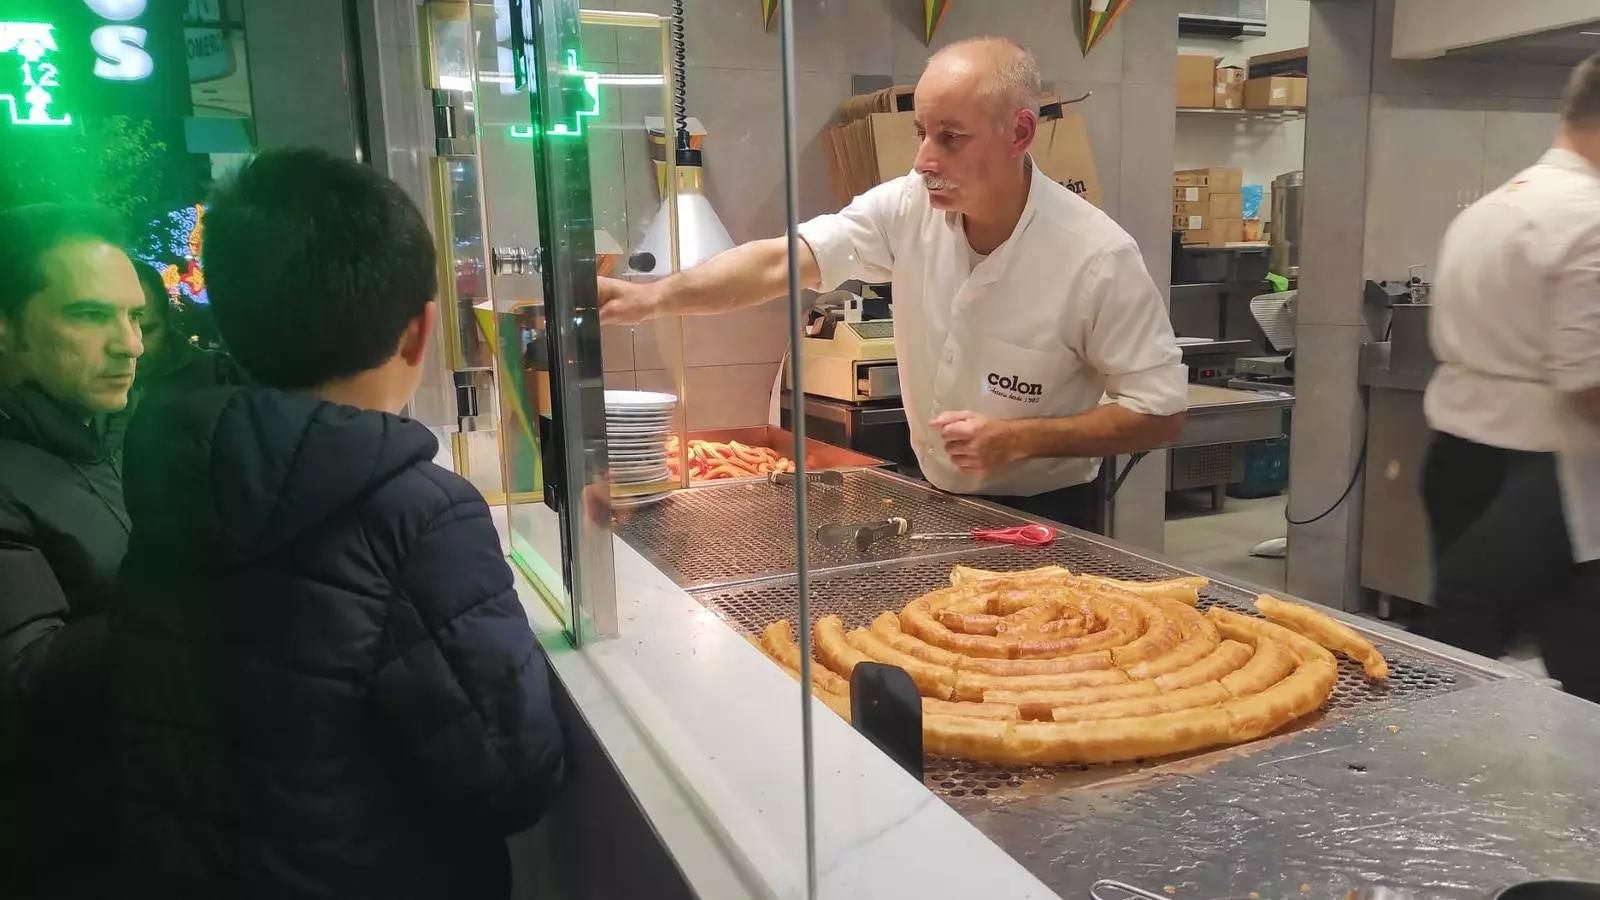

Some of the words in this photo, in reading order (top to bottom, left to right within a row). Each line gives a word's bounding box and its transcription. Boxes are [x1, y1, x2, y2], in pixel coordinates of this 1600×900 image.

[21, 62, 60, 86] 12
[1059, 178, 1087, 194] ón
[987, 372, 1043, 396] colon
